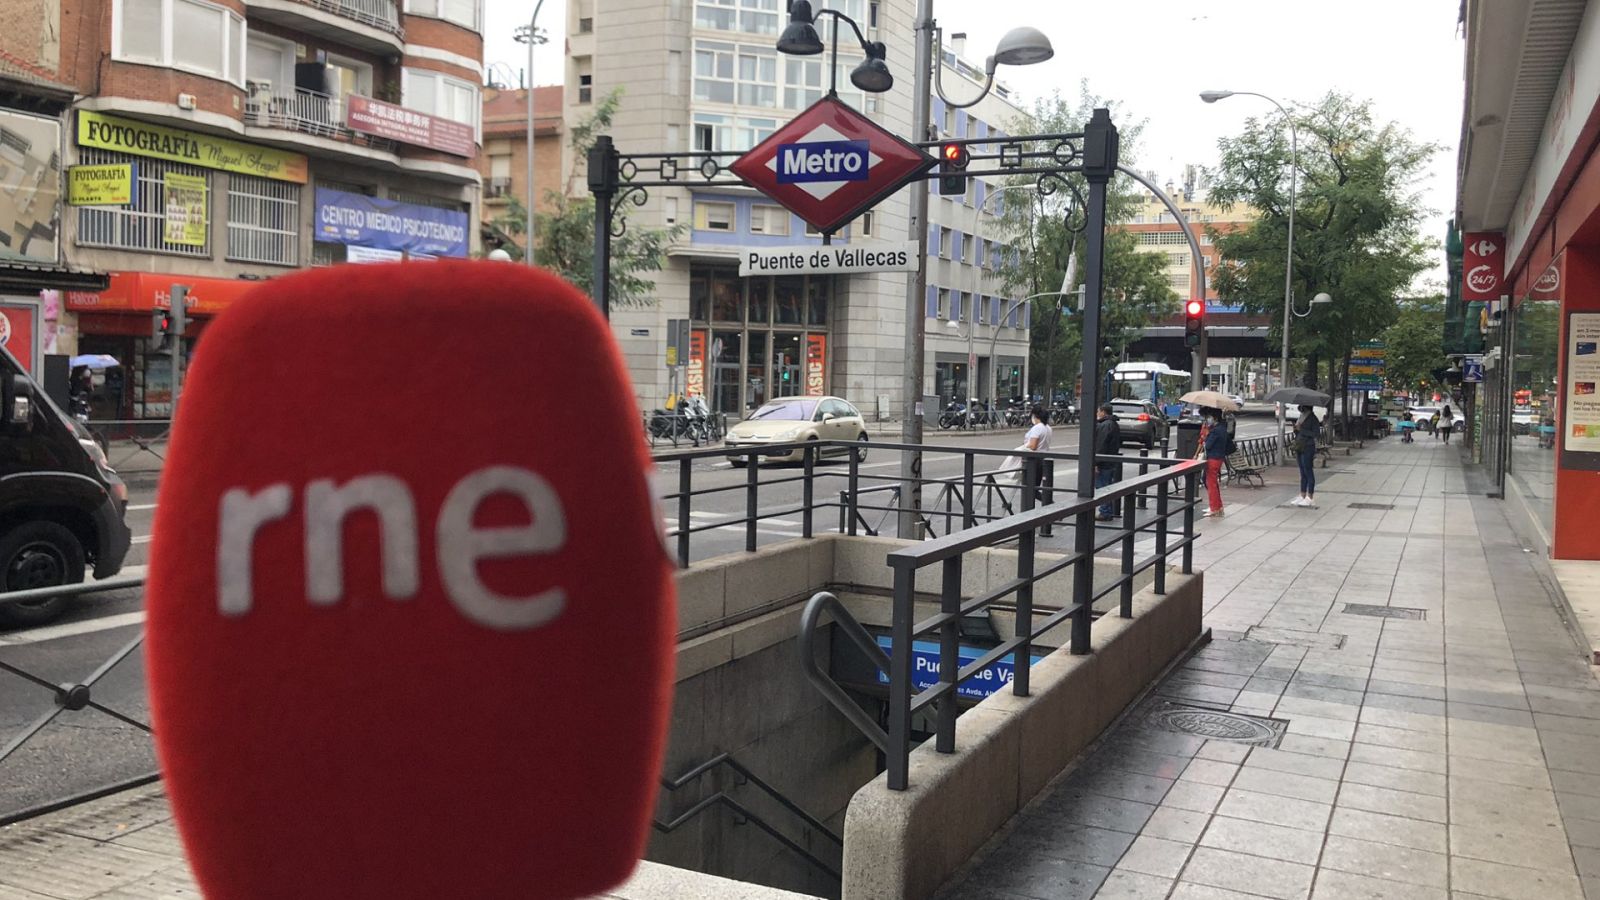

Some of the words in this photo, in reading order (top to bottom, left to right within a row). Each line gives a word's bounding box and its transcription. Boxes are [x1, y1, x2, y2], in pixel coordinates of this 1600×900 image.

[87, 119, 201, 160] FOTOGRAFÍA
[203, 143, 243, 169] Miguel
[784, 149, 862, 175] Metro
[321, 205, 364, 228] CENTRO
[366, 209, 401, 234] MÉDICO
[749, 252, 804, 270] Puente
[809, 252, 830, 268] de
[835, 249, 907, 268] Vallecas
[1472, 275, 1496, 285] 24/7
[155, 290, 198, 308] Haon
[217, 466, 567, 629] rne
